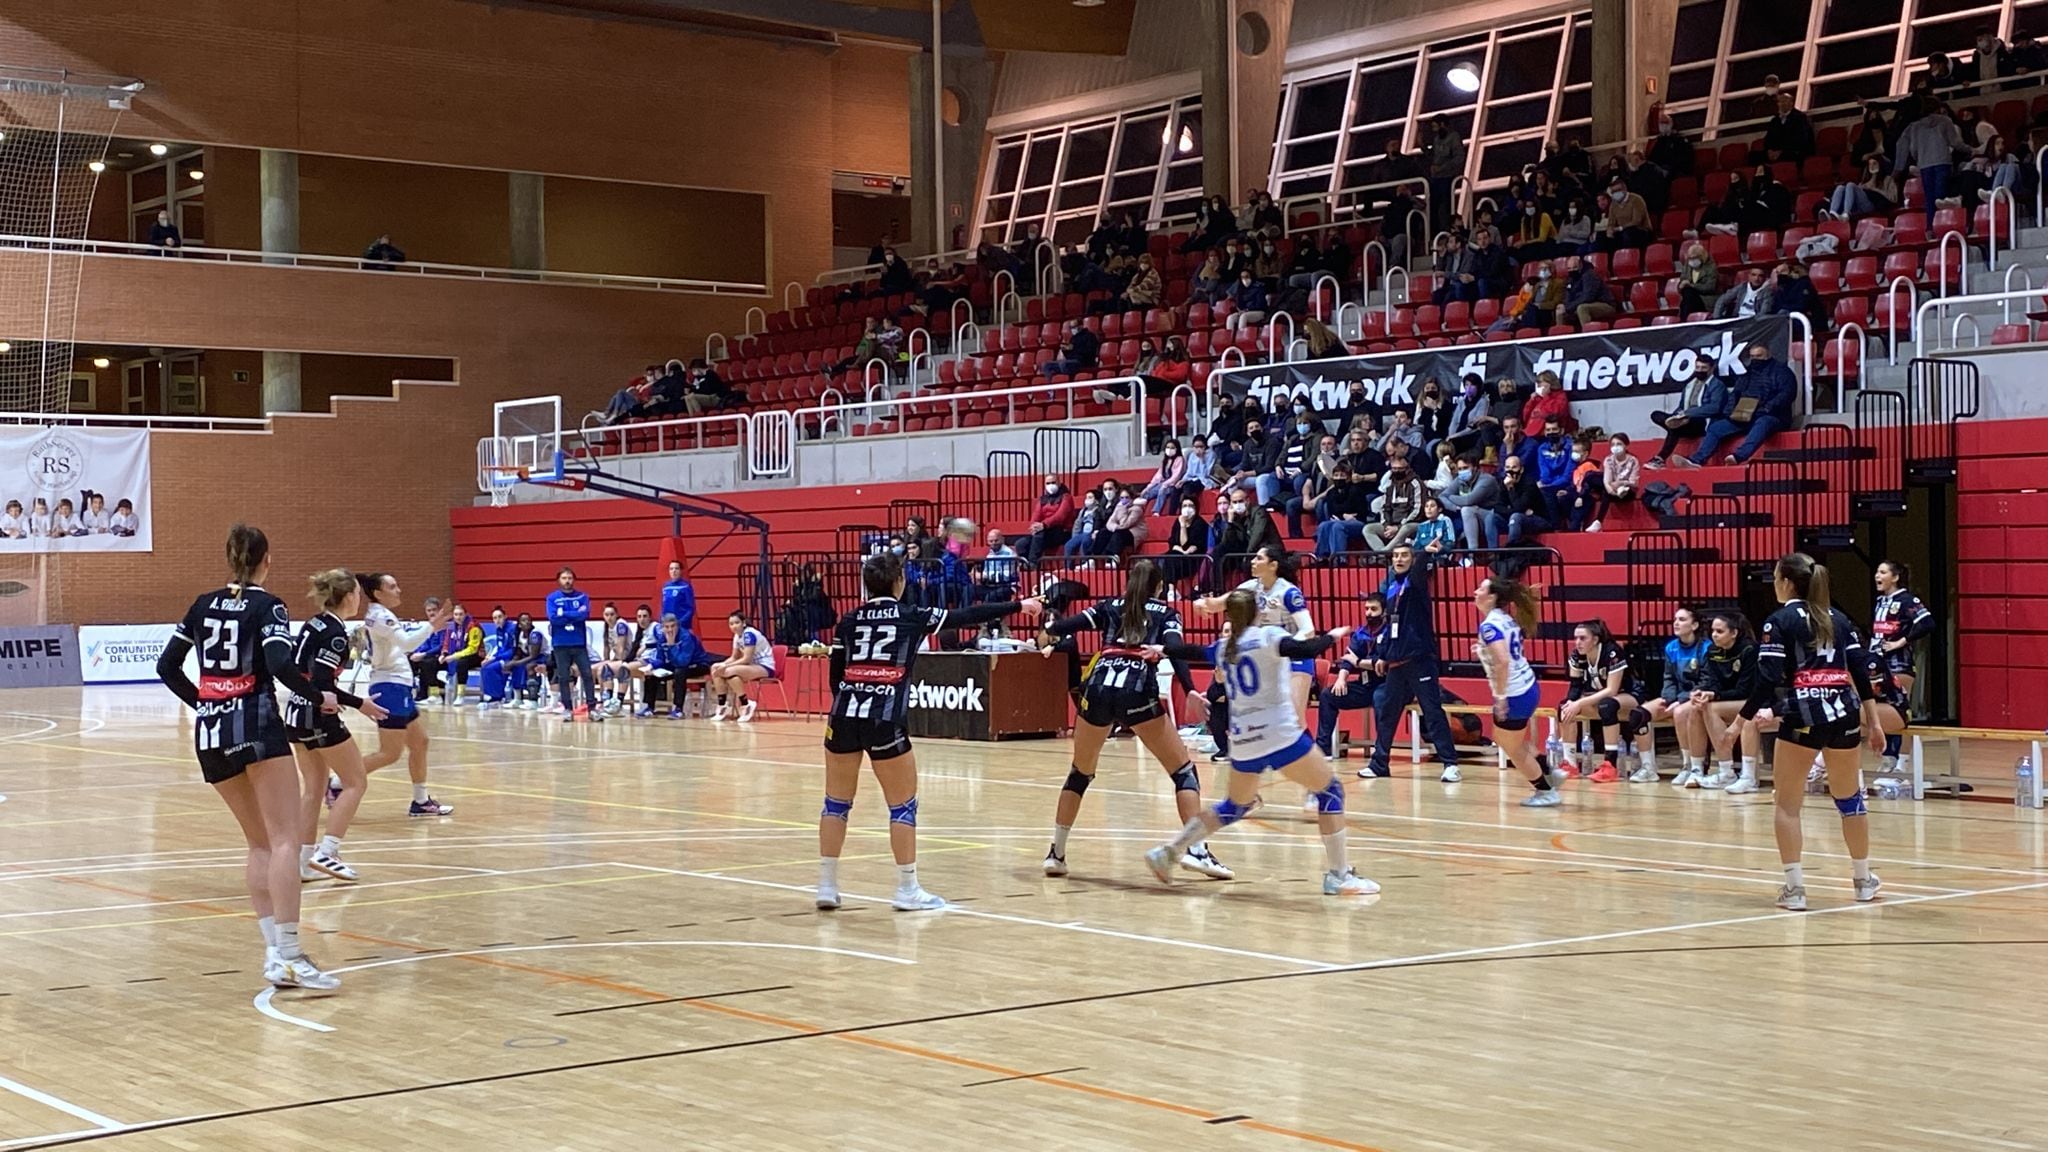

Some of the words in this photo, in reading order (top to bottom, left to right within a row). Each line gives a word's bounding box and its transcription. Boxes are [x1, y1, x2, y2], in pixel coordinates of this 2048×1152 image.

[42, 457, 70, 474] RS
[105, 645, 164, 655] COMUNITAT
[203, 617, 239, 670] 23
[852, 625, 897, 661] 32
[110, 655, 123, 663] DE
[126, 653, 162, 663] L'ESPO
[908, 677, 984, 711] etwork
